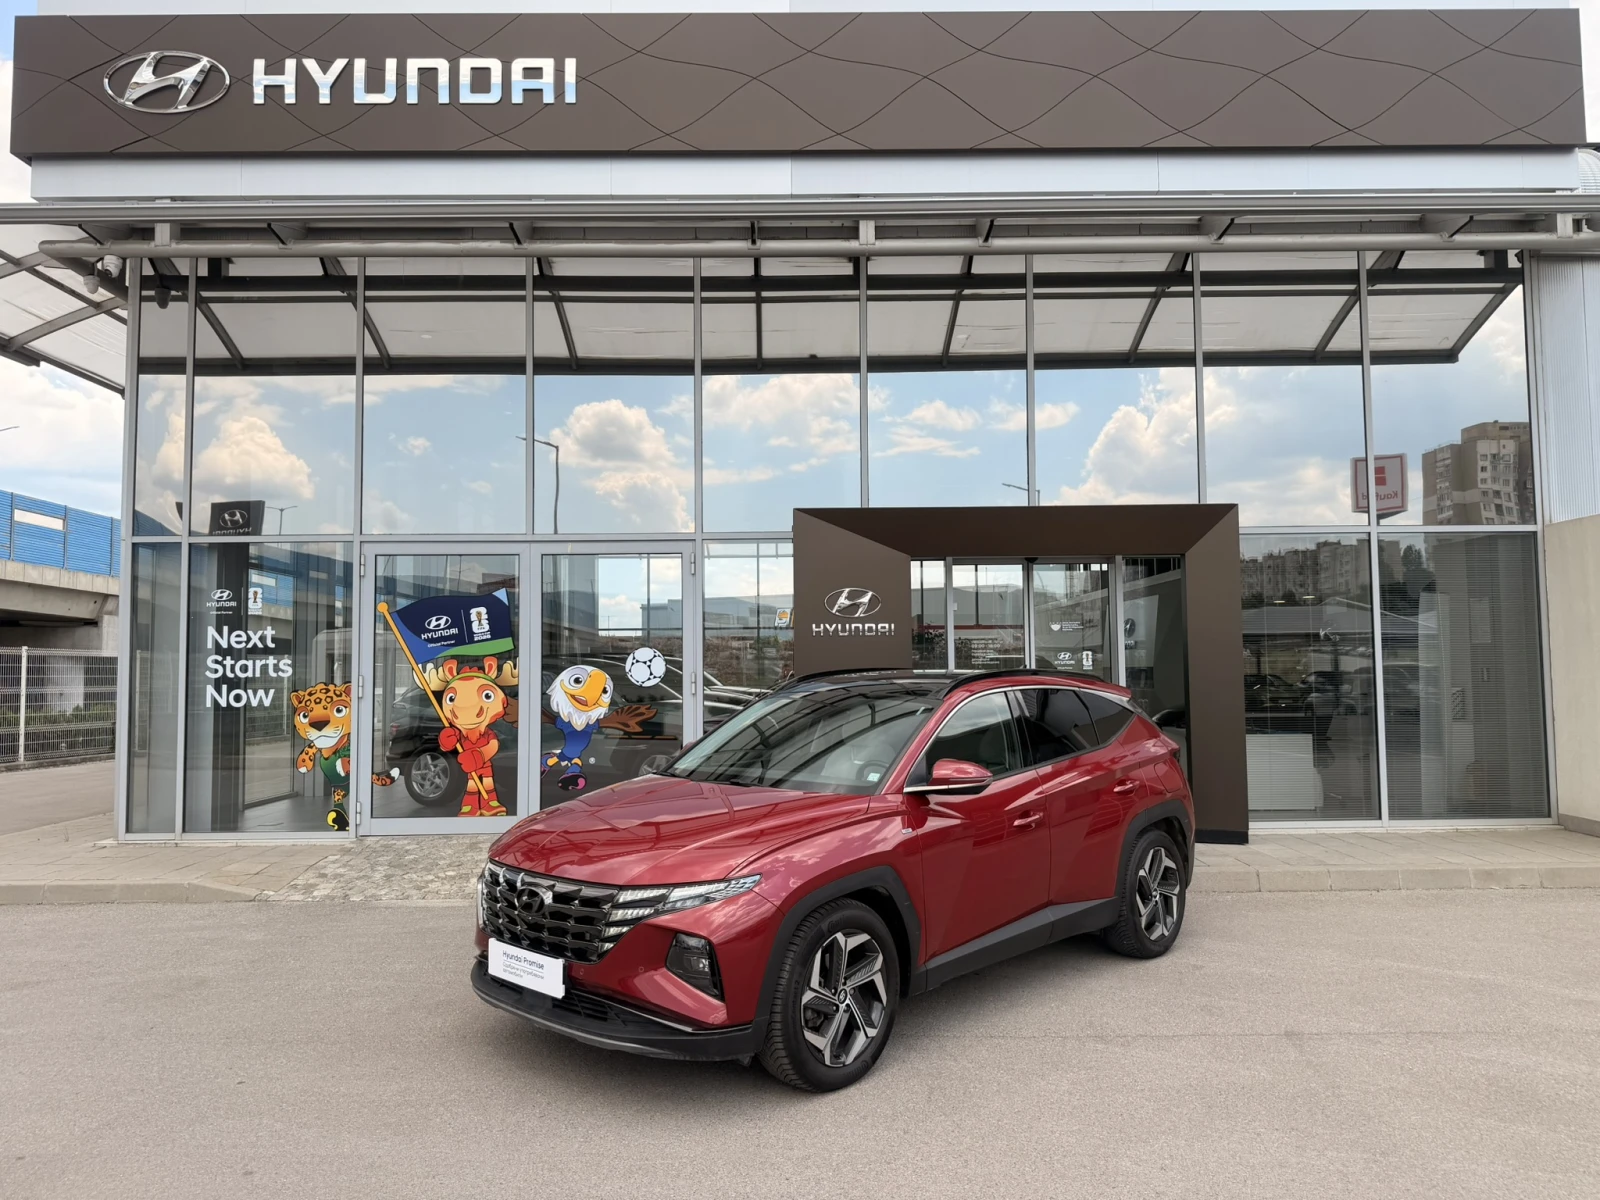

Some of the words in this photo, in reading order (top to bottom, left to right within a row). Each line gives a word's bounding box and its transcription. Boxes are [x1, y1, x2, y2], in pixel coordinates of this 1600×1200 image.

[252, 58, 577, 105] HYUNDAI
[206, 626, 276, 649] Next
[421, 628, 458, 640] HYUNDAI
[812, 623, 895, 636] HYUNDAI
[205, 654, 293, 678] Starts
[206, 684, 275, 708] Now
[503, 950, 523, 962] Hyundai
[524, 956, 544, 970] Promise
